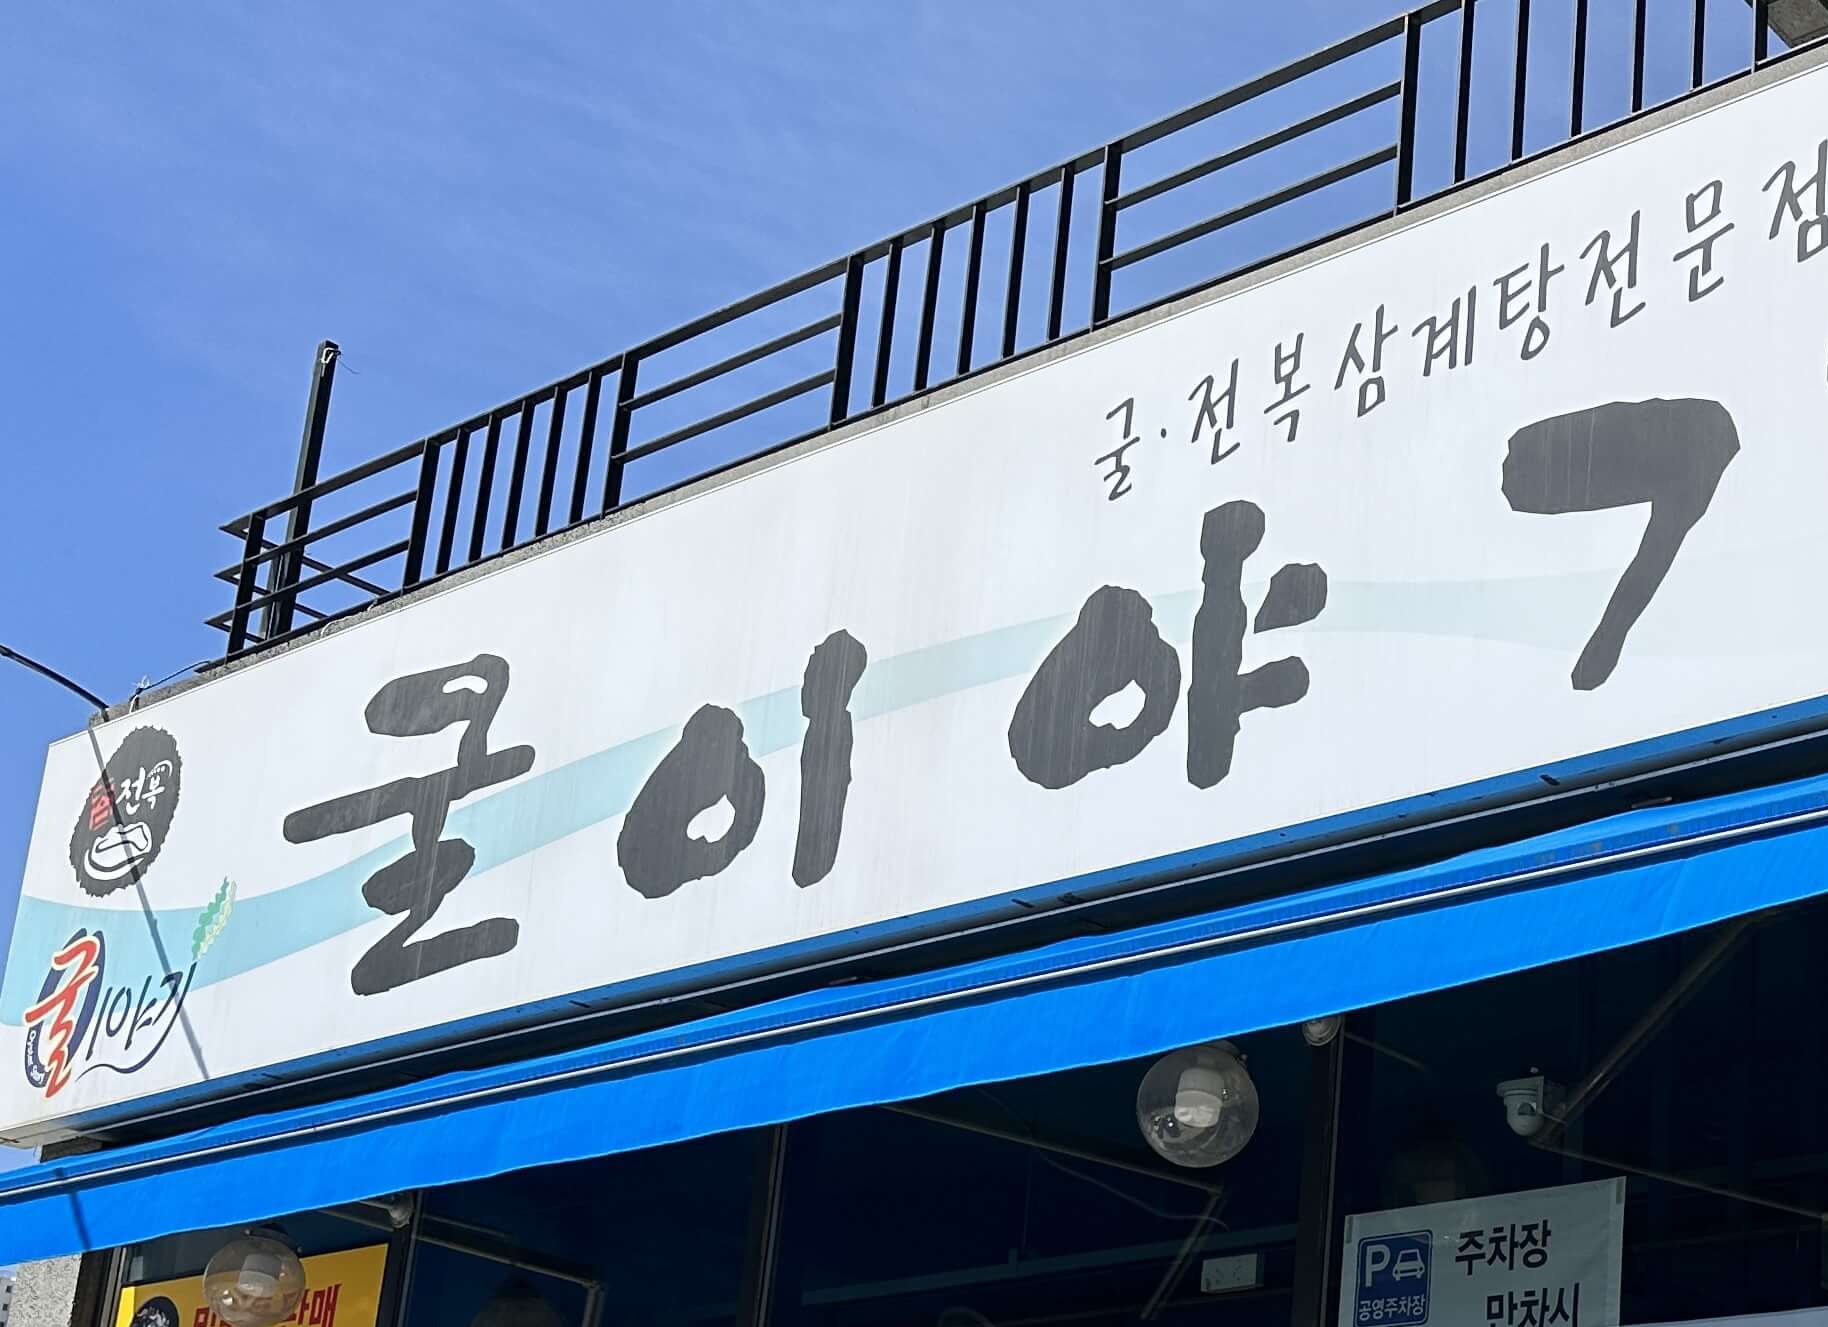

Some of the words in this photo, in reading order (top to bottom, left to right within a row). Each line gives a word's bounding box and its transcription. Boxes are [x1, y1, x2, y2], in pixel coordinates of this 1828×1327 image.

[1365, 1245, 1390, 1287] P
[1455, 1220, 1551, 1275] 주차장
[1358, 1295, 1426, 1321] 공영주차장
